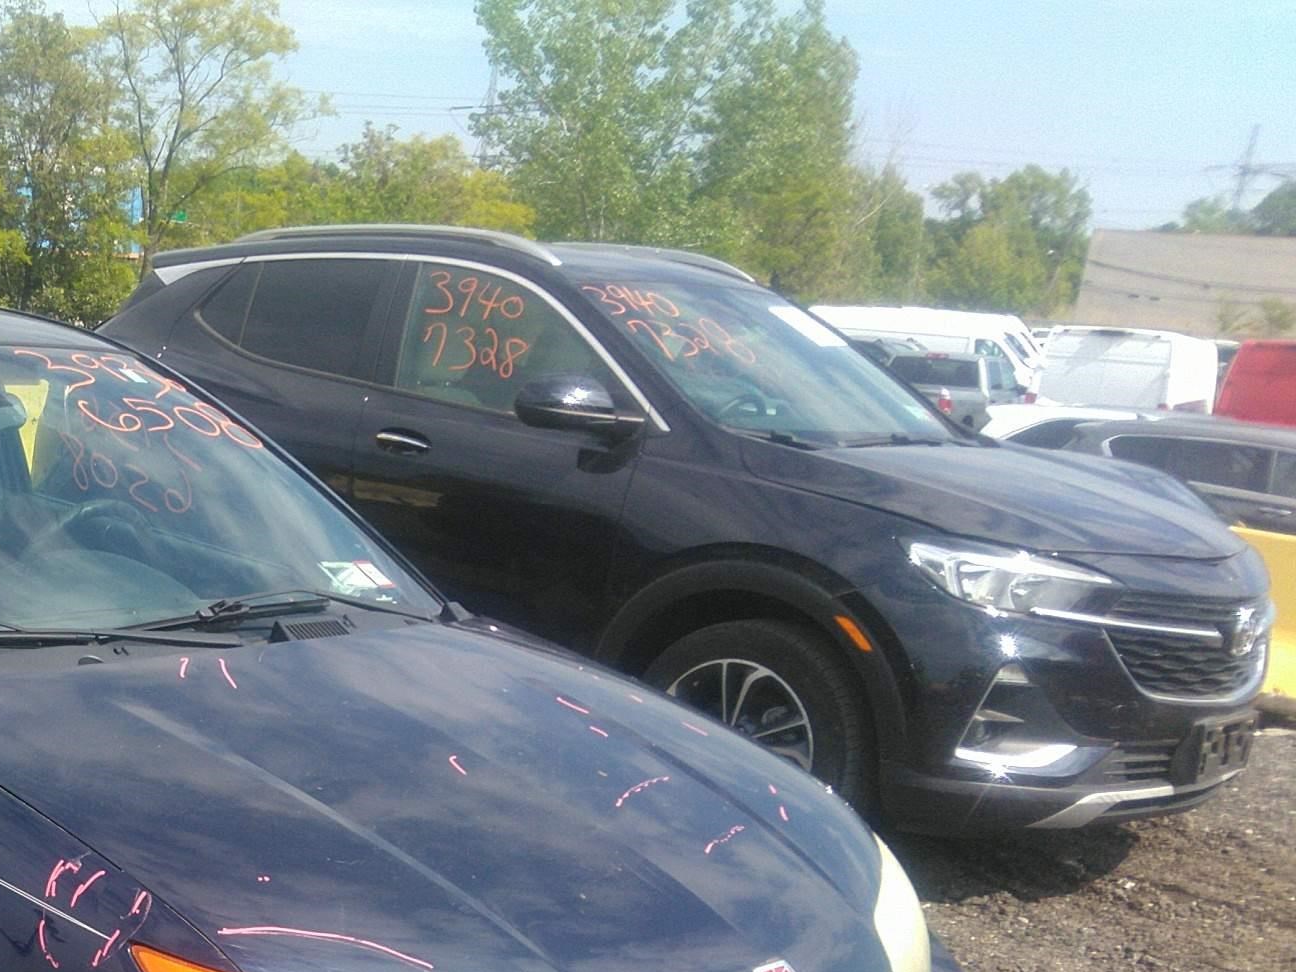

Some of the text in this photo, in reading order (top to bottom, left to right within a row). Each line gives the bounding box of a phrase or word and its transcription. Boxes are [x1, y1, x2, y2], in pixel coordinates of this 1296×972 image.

[424, 271, 525, 320] 3940
[582, 285, 680, 317] 3940
[423, 321, 530, 379] 7328
[626, 317, 756, 365] 7328
[78, 396, 264, 449] 6508
